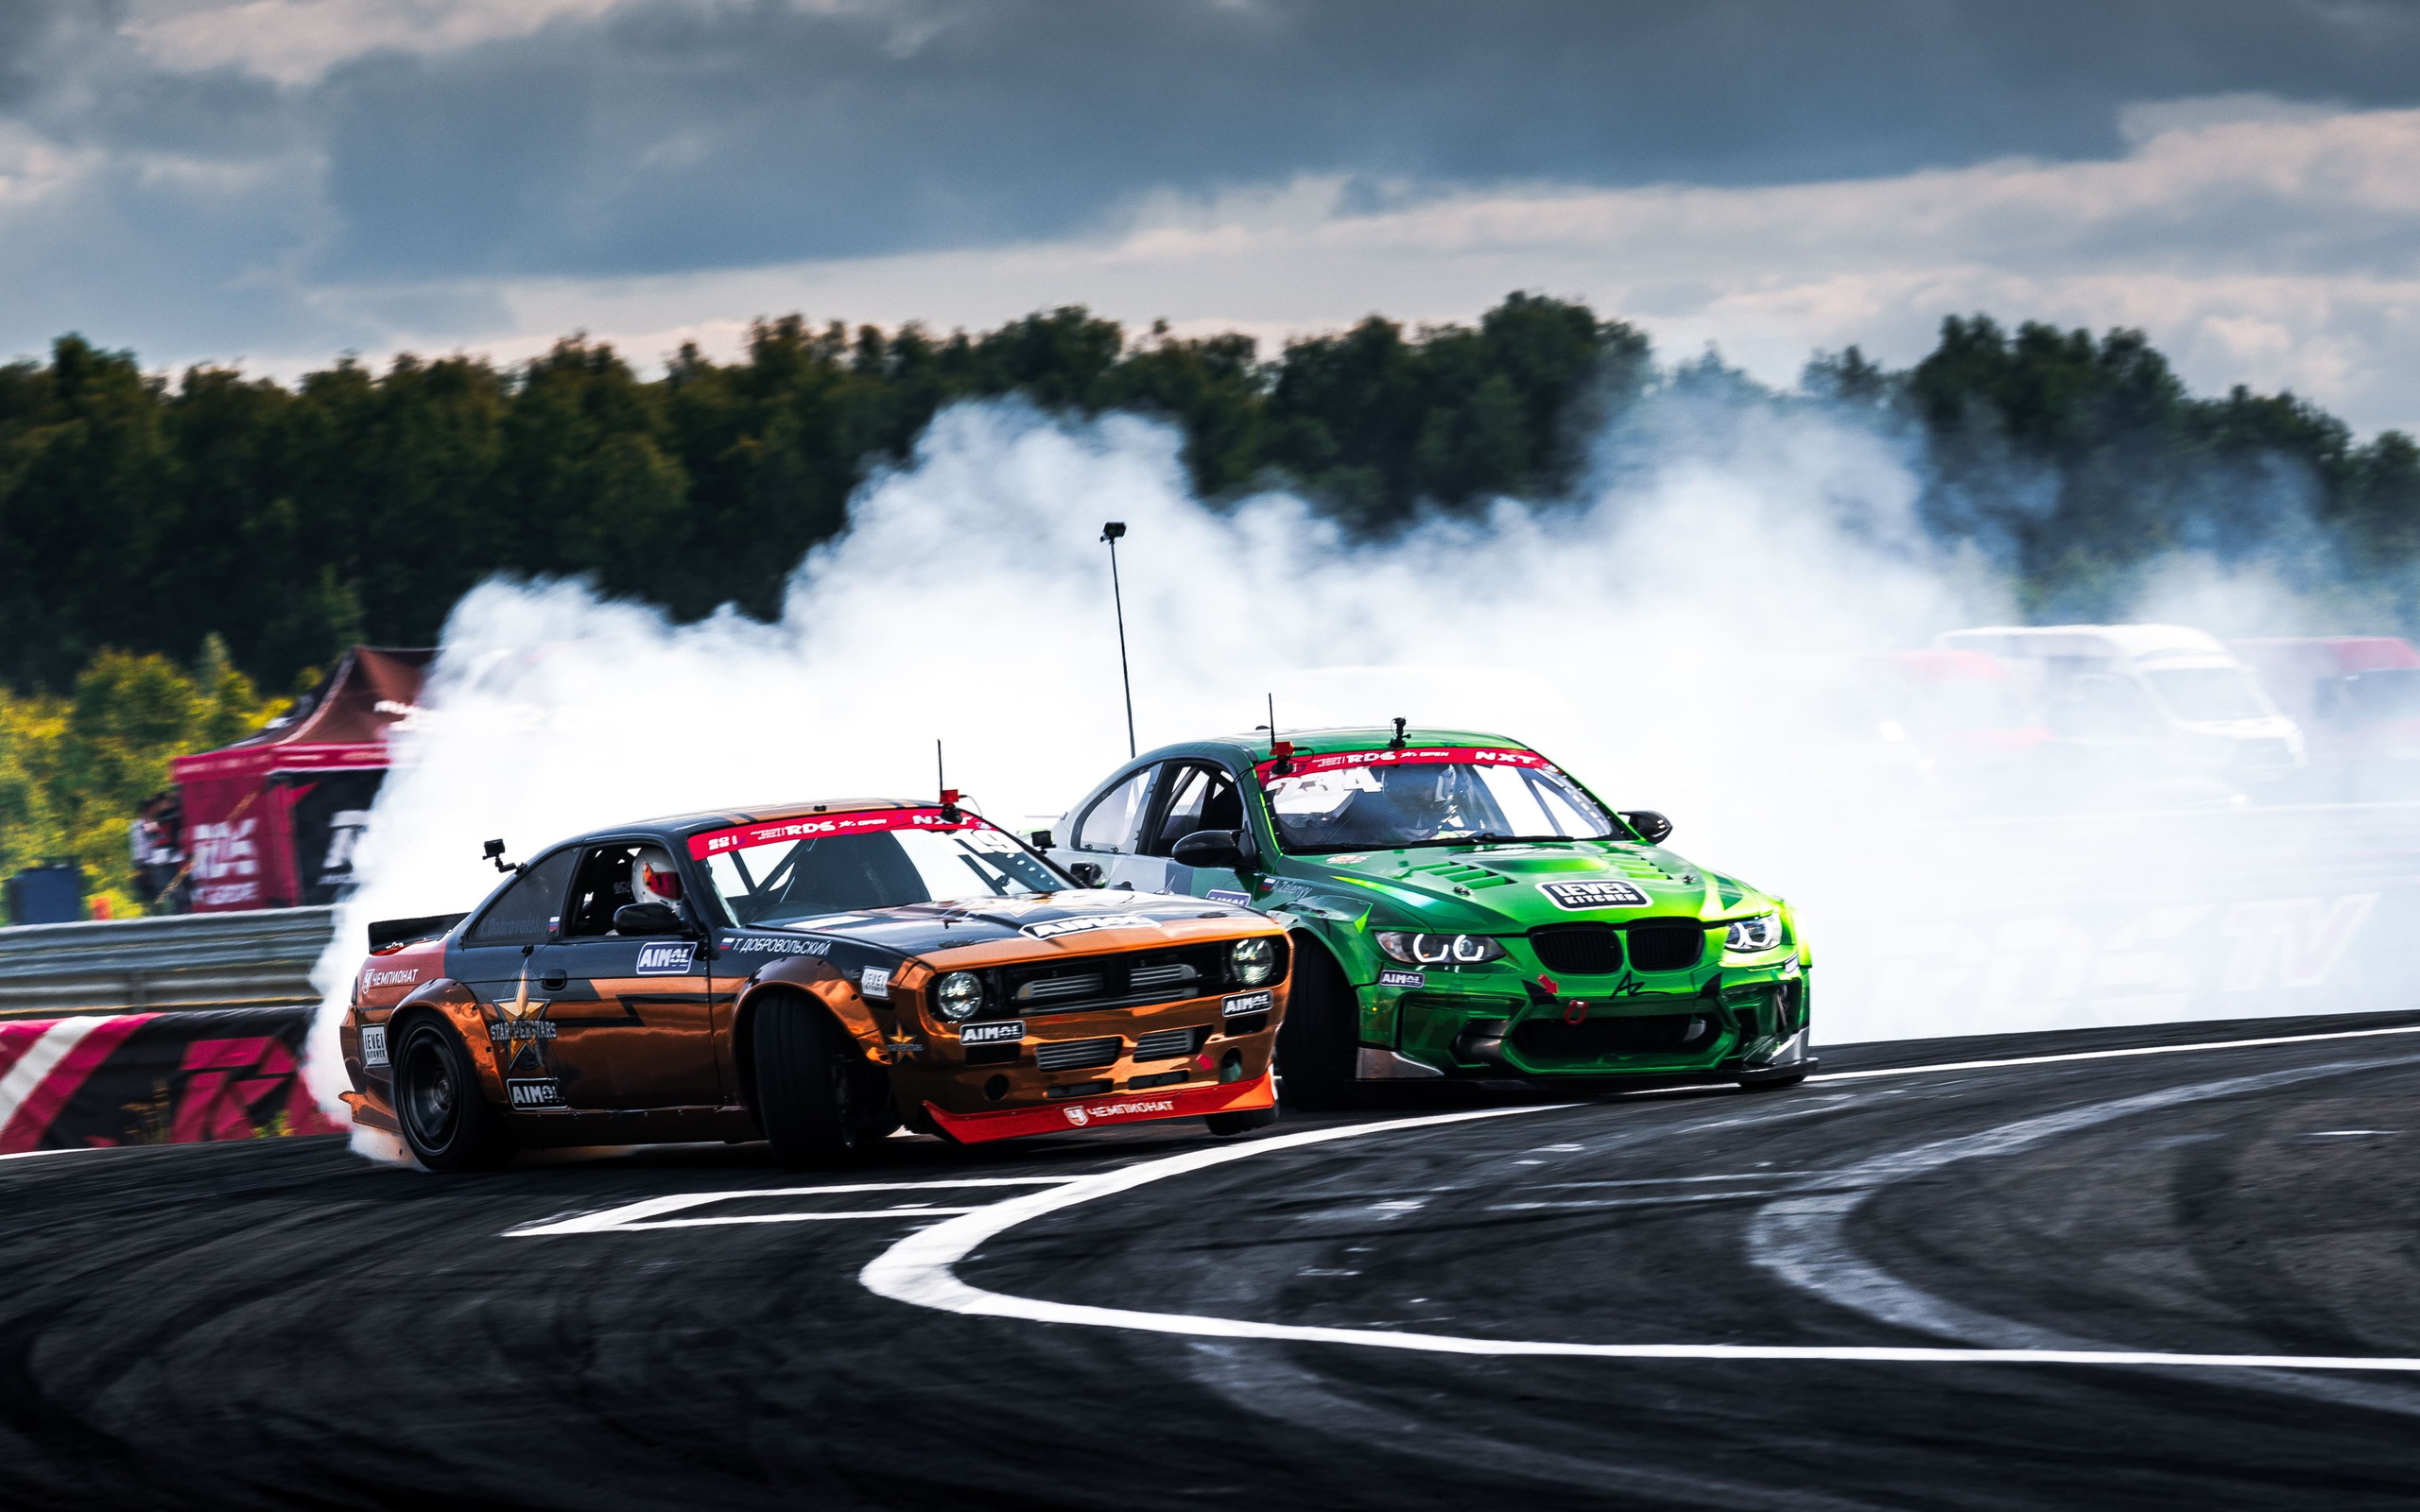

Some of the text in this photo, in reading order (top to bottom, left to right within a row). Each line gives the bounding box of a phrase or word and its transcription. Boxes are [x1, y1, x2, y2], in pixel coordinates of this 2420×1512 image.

[1346, 751, 1396, 764] RDS
[1475, 751, 1537, 765] NXT
[785, 821, 836, 835] RDS
[1278, 881, 1313, 898] Zelenyy
[1550, 883, 1632, 897] LEVEL
[1563, 893, 1639, 904] KITCHEN
[639, 948, 690, 968] AIMOL
[372, 969, 419, 986] ЧЕМПИОНАТ
[1382, 973, 1422, 986] AIMOL
[1224, 994, 1271, 1013] AIMOL
[962, 1025, 1021, 1041] AIMOL
[1086, 1100, 1174, 1118] ЧЕМПИОНАТ
